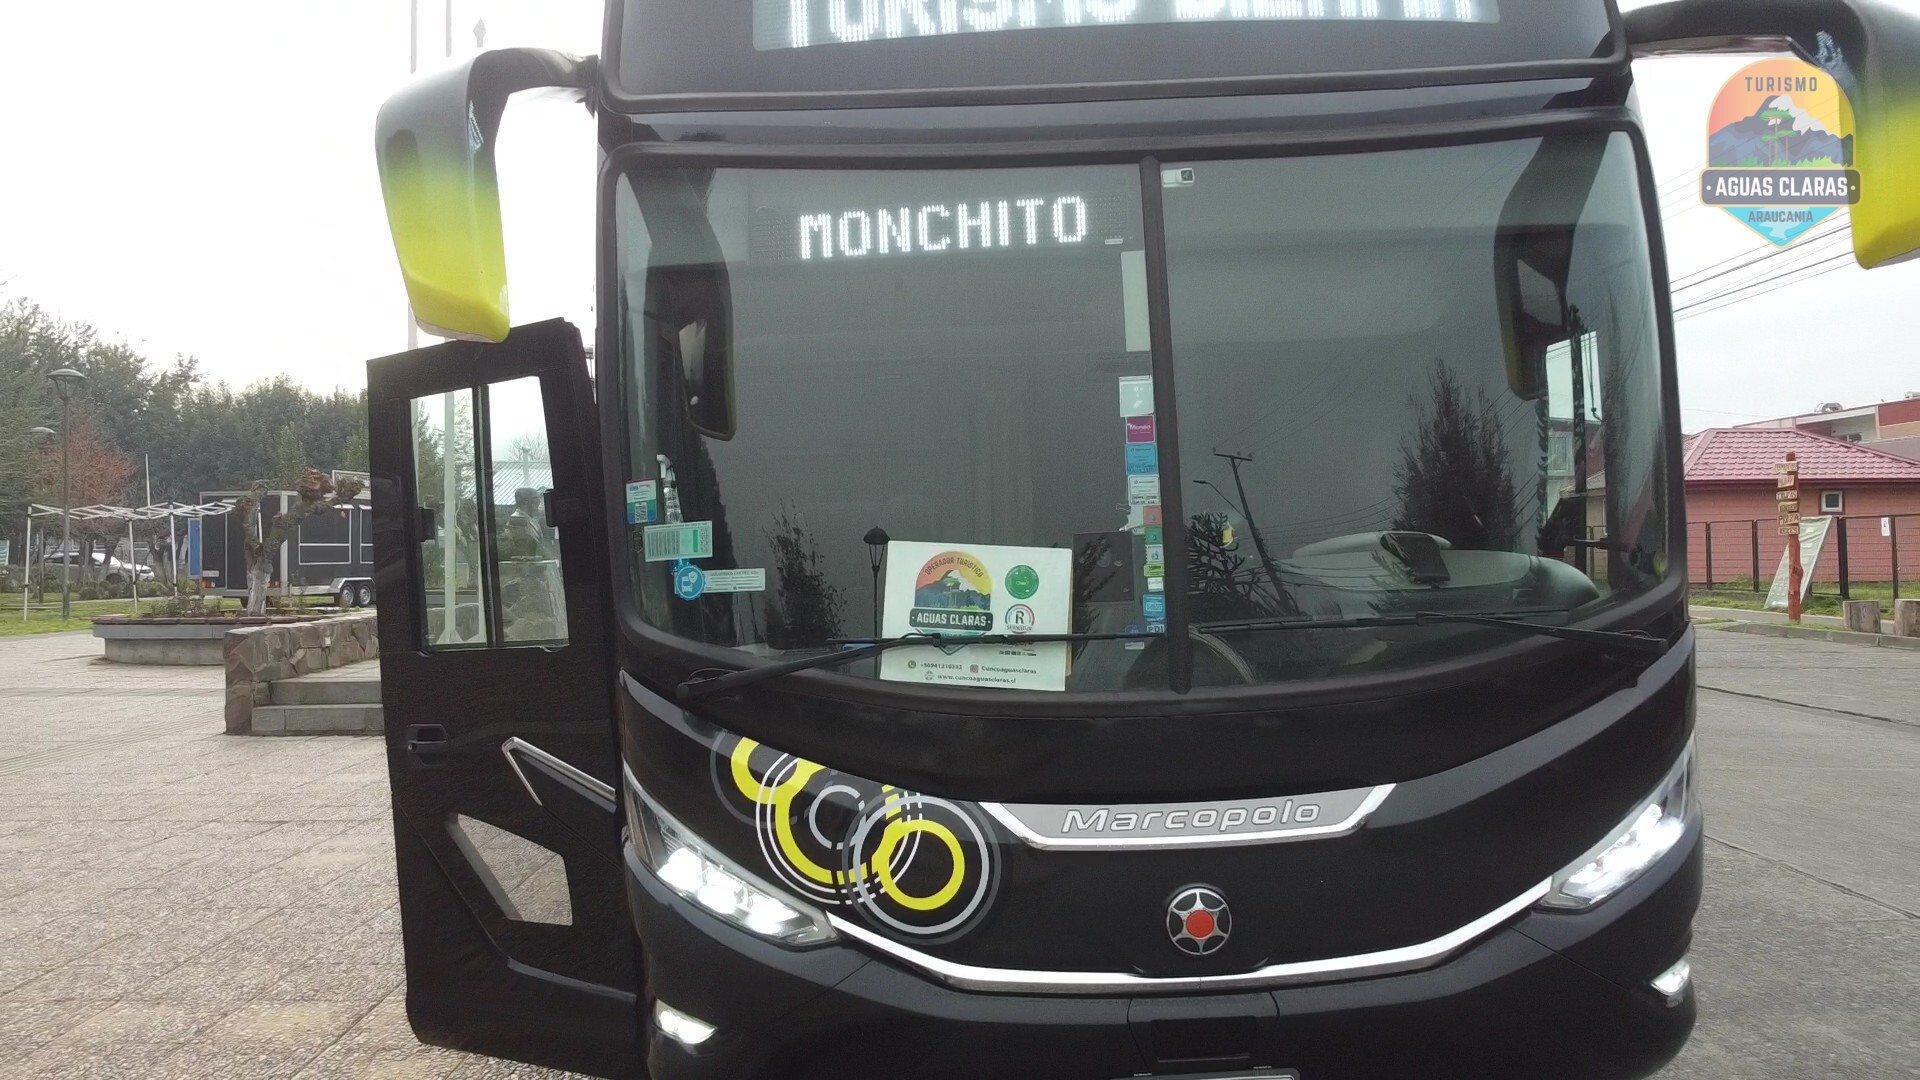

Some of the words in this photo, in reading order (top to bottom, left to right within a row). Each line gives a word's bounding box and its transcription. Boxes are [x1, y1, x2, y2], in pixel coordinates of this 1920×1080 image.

[800, 195, 1087, 260] MONCHITO
[924, 556, 955, 576] OPERADOR
[916, 612, 947, 624] AGUAS
[950, 614, 987, 627] CLARAS
[1061, 799, 1321, 833] Marcopolo
